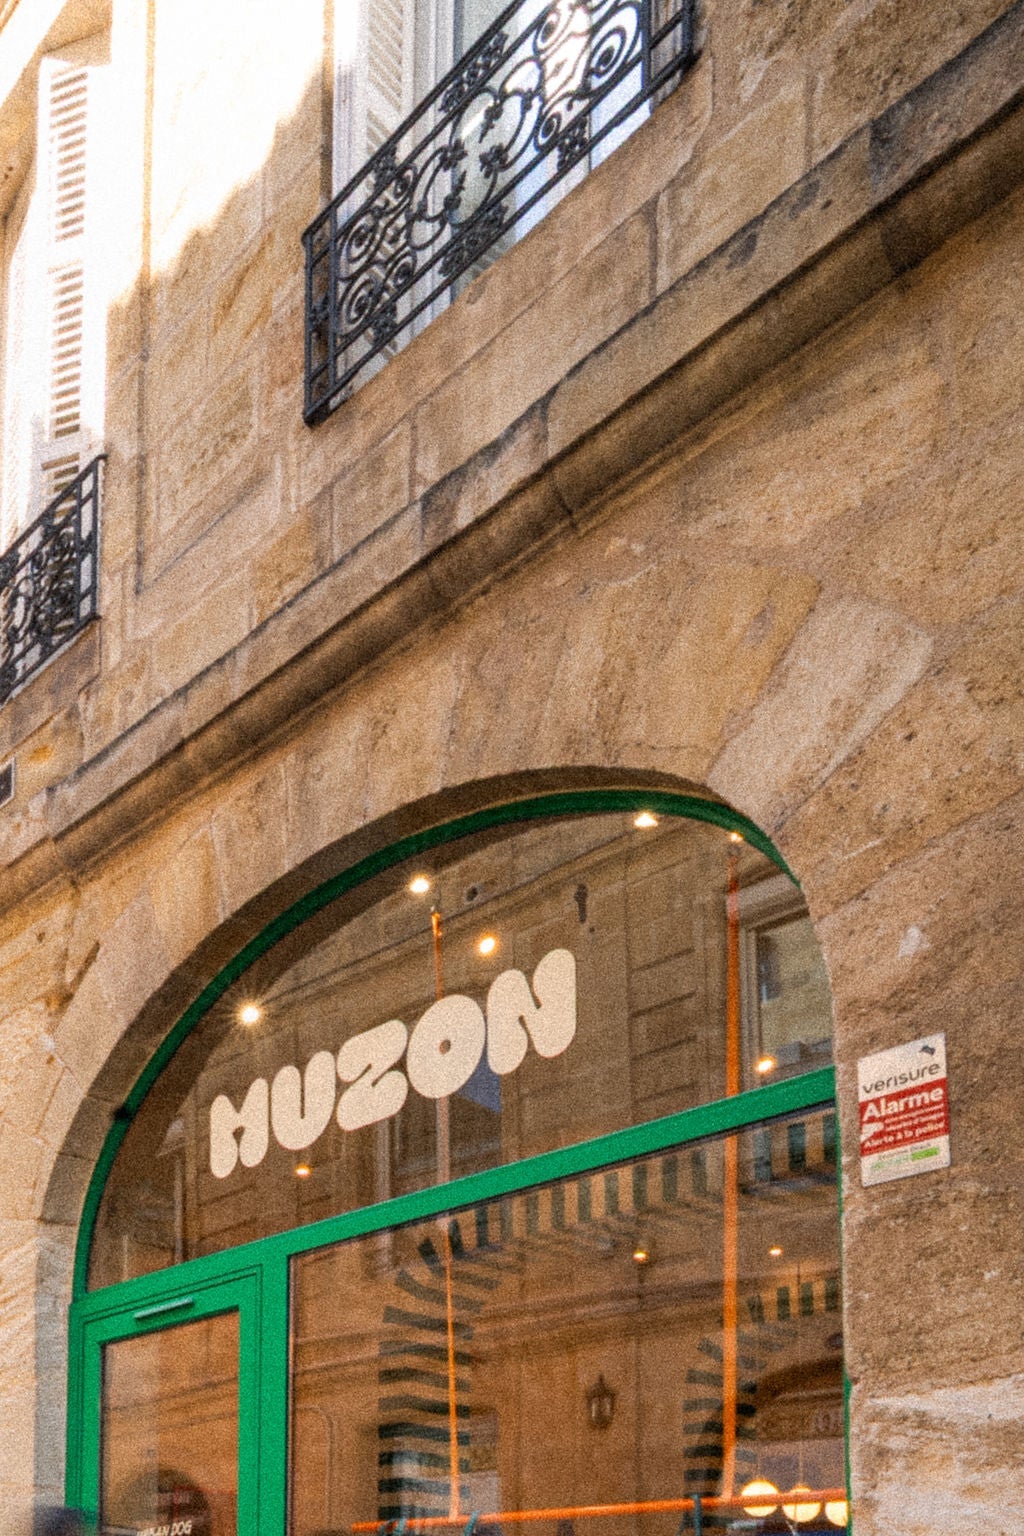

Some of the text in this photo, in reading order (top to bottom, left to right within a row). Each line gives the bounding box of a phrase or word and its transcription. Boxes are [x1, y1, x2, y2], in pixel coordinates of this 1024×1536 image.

[209, 948, 577, 1180] MUZON
[863, 1063, 940, 1093] verisure
[863, 1088, 943, 1121] Alarme
[170, 1520, 192, 1536] DOG
